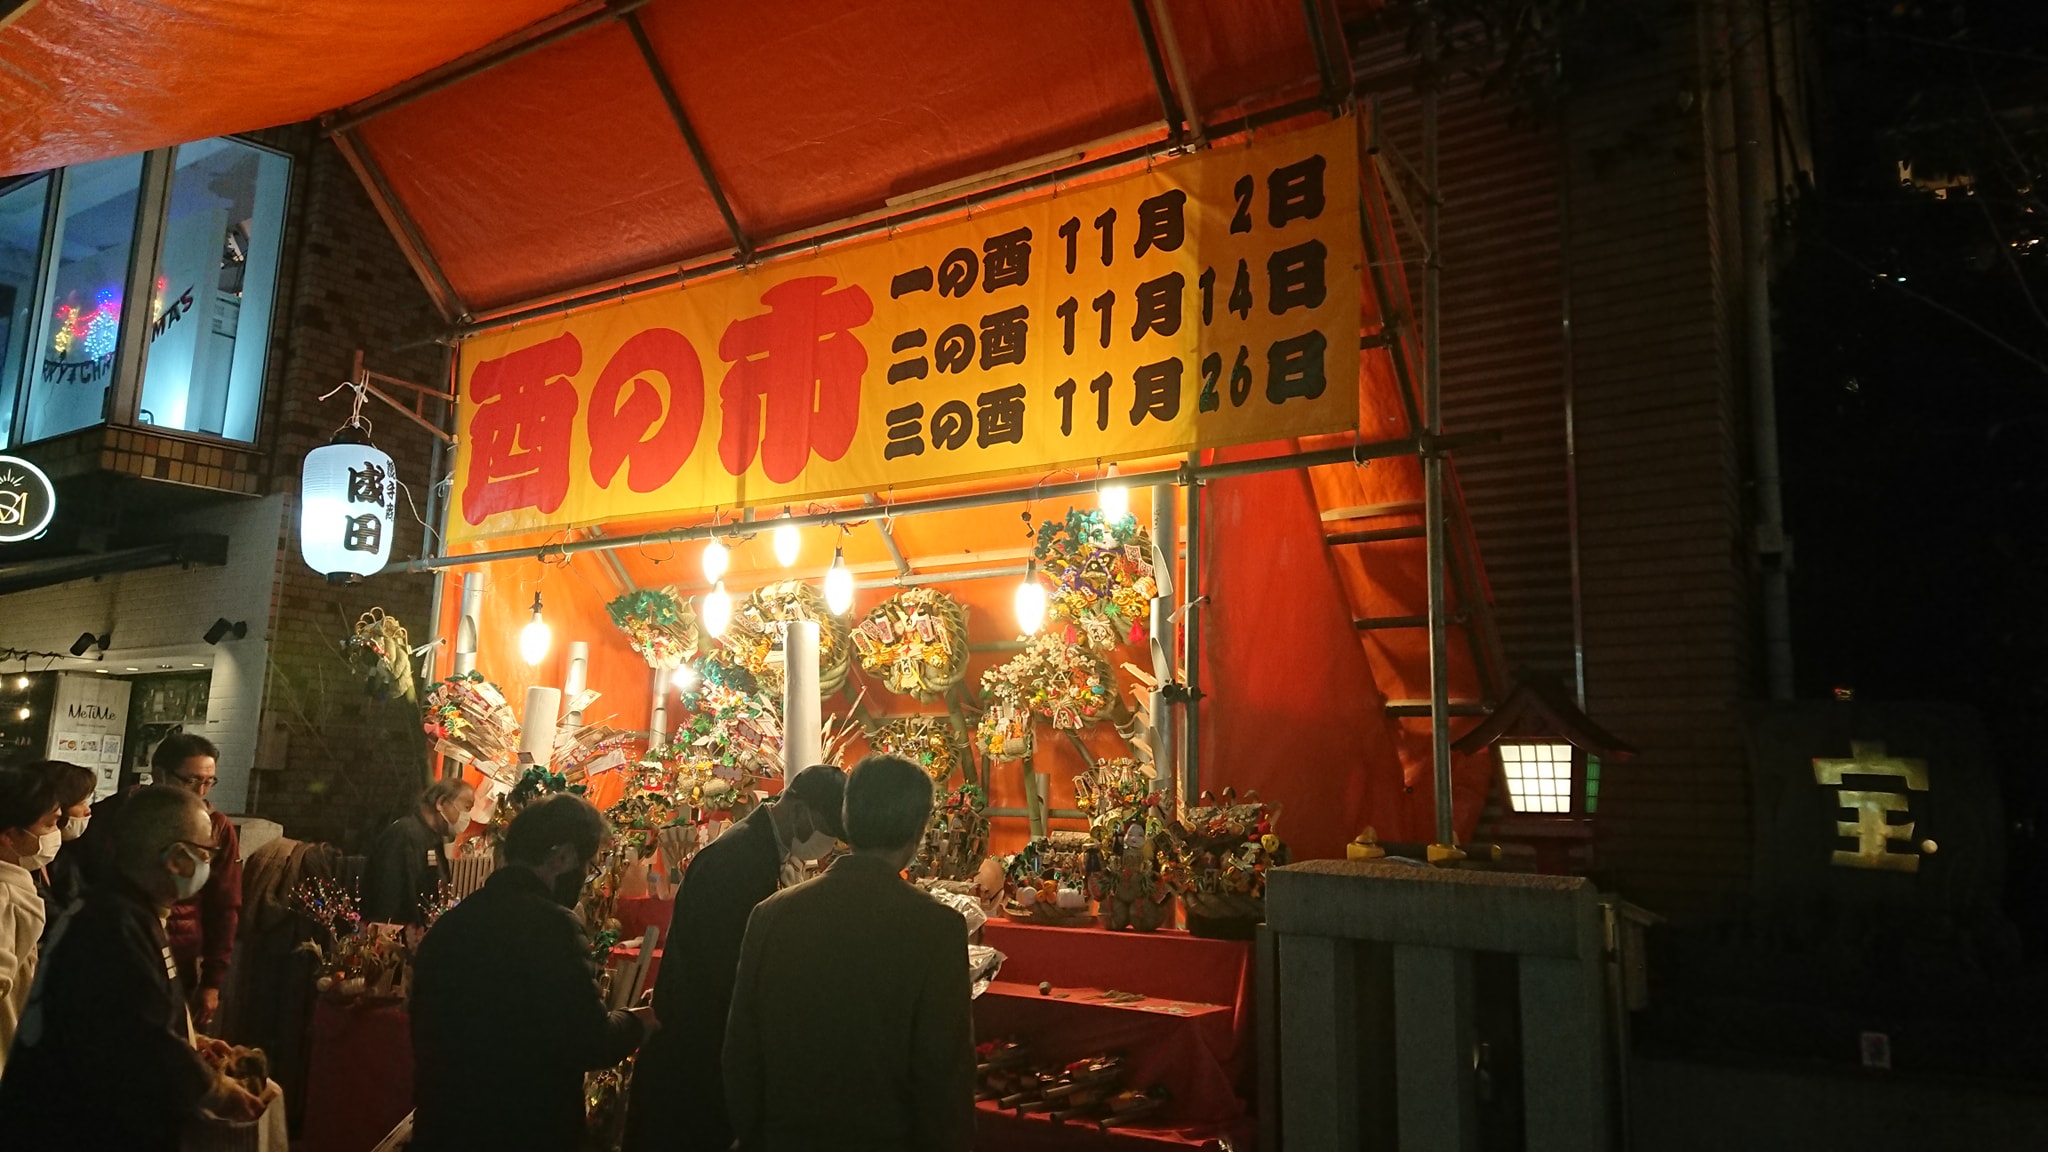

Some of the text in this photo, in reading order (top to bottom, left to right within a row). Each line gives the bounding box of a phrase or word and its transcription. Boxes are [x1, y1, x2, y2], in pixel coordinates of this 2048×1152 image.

[891, 152, 1328, 299] 一の酉 11月 2日
[887, 305, 1028, 385] 二の酉
[462, 276, 874, 526] 酉の市
[884, 384, 1026, 461] 三の酉
[343, 461, 385, 555] 成田
